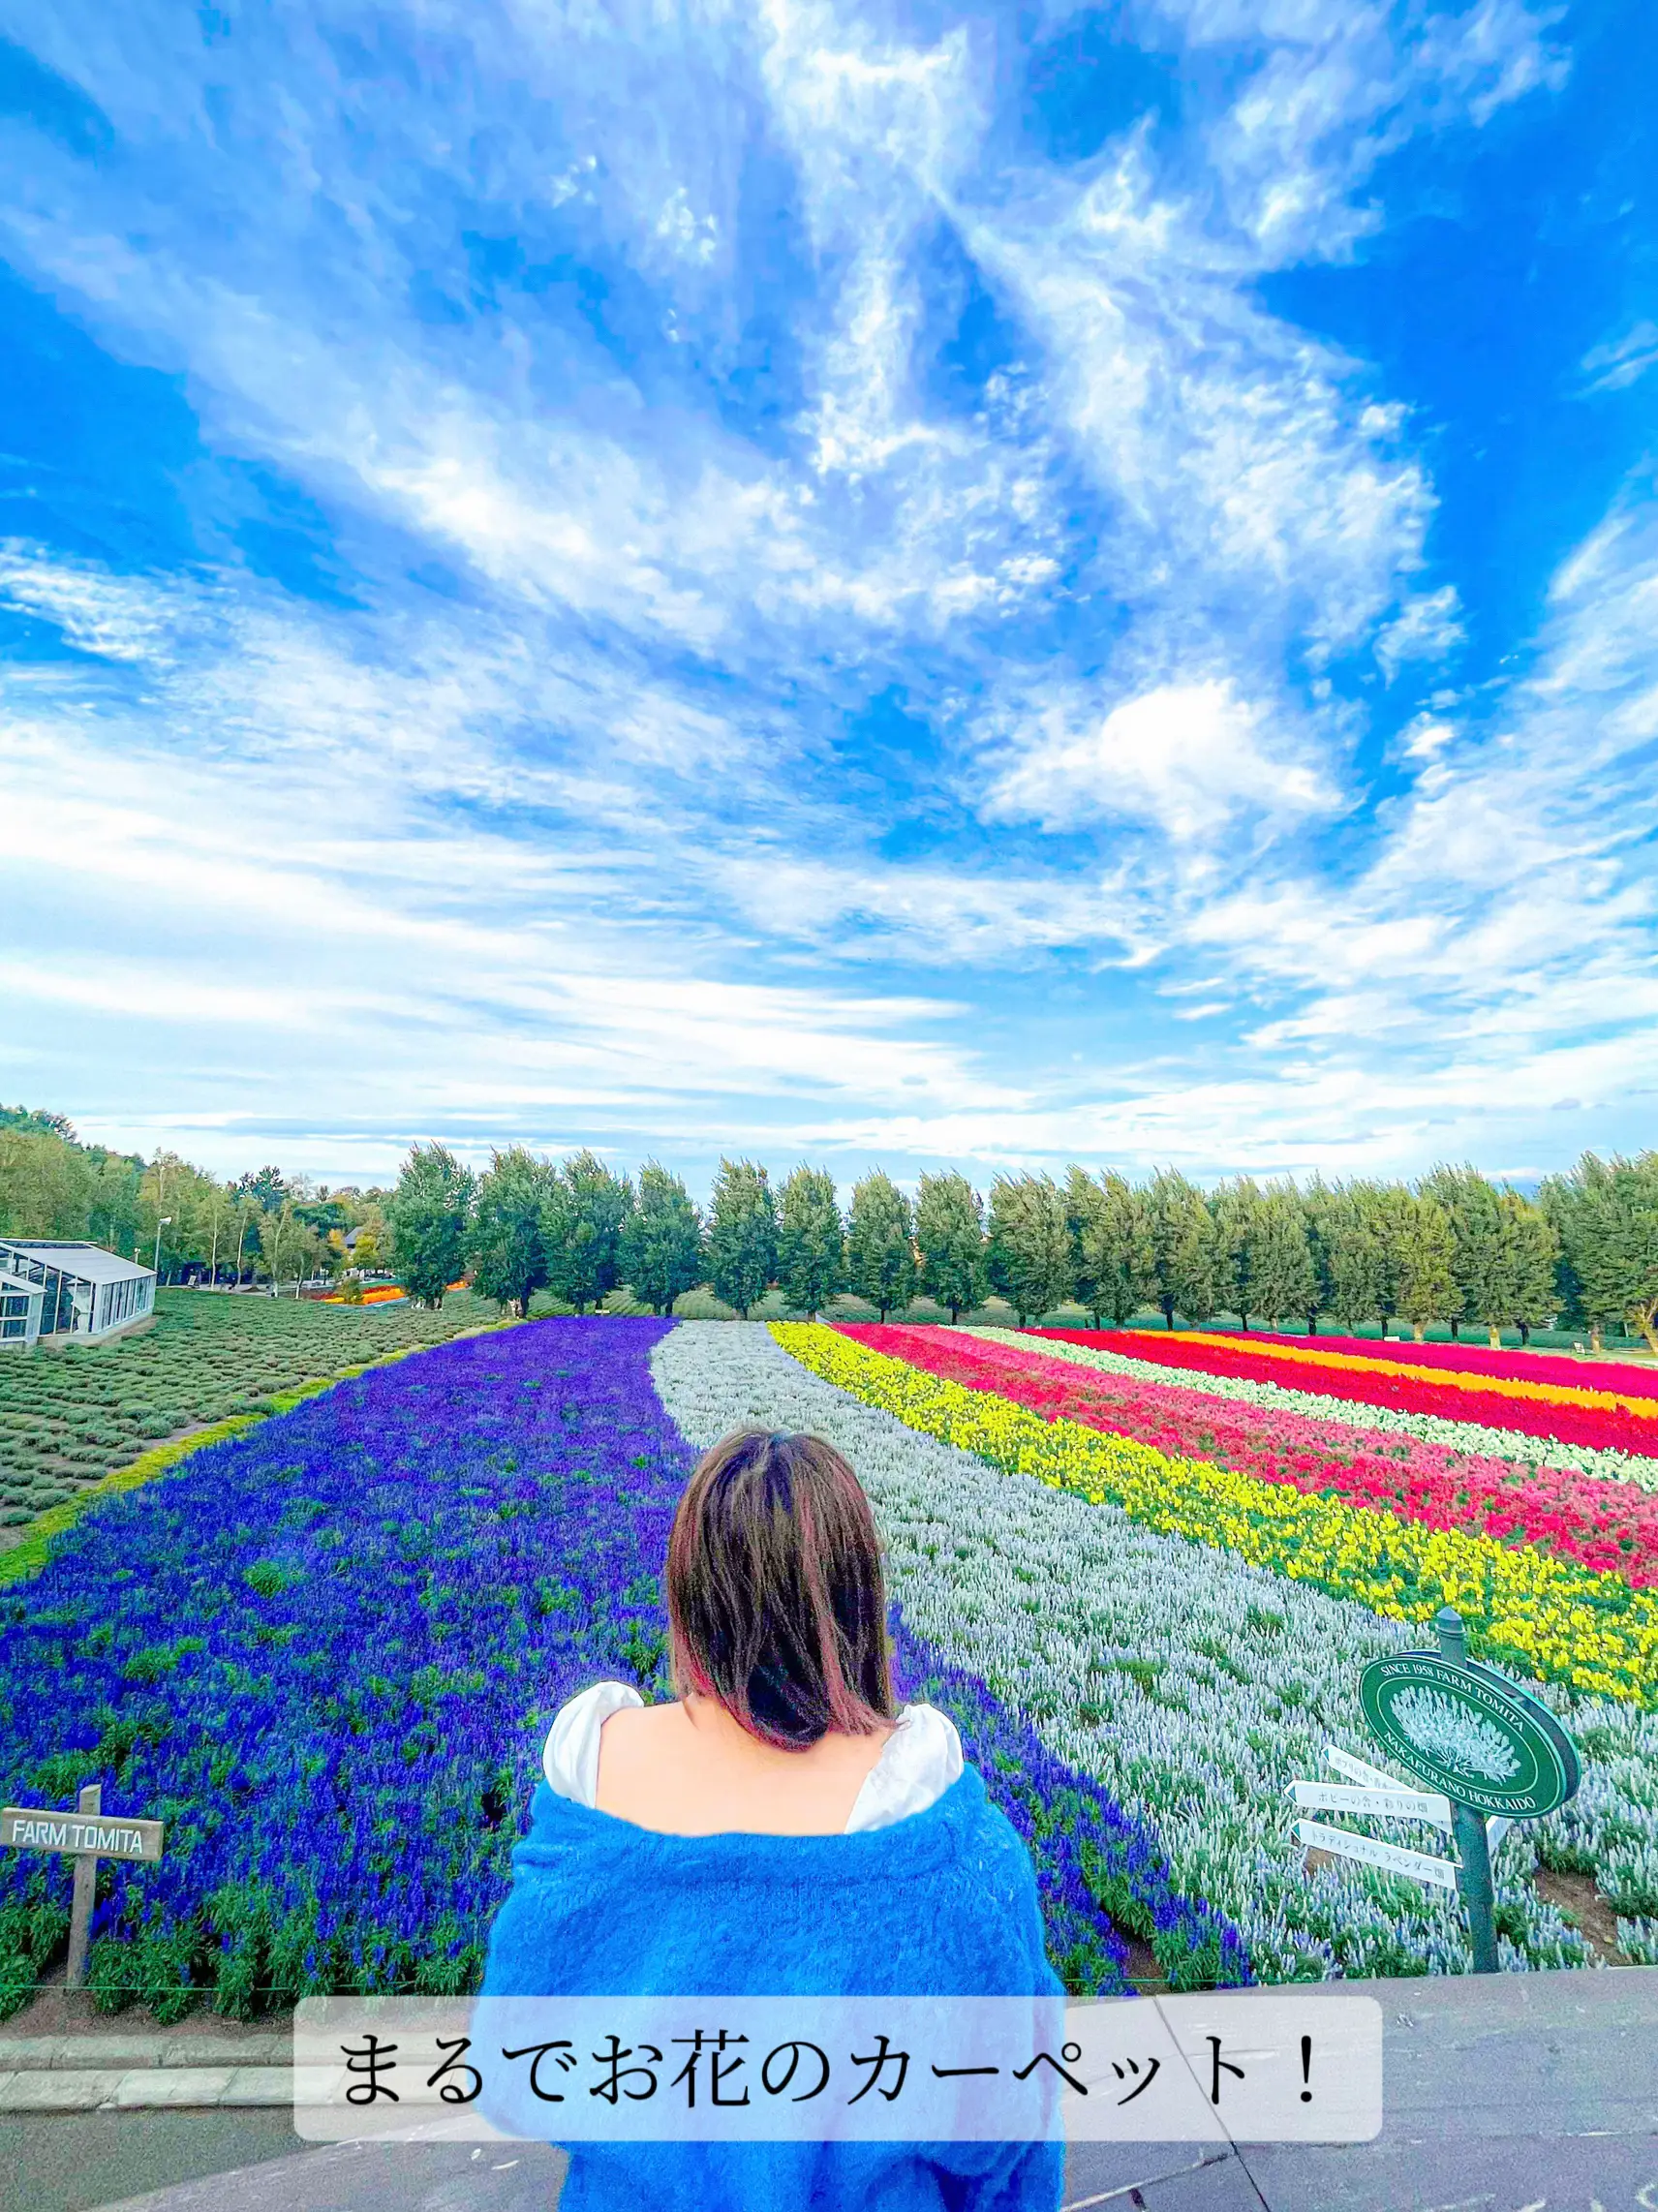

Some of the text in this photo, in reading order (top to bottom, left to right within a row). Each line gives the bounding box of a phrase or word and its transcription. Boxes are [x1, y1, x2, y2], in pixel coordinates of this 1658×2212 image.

[1380, 1663, 1525, 1733] SINCE 1958 FARM TOMITA
[1384, 1731, 1536, 1810] NAKAFURANO HOKKAIDO
[12, 1819, 143, 1854] FARM TOMITA
